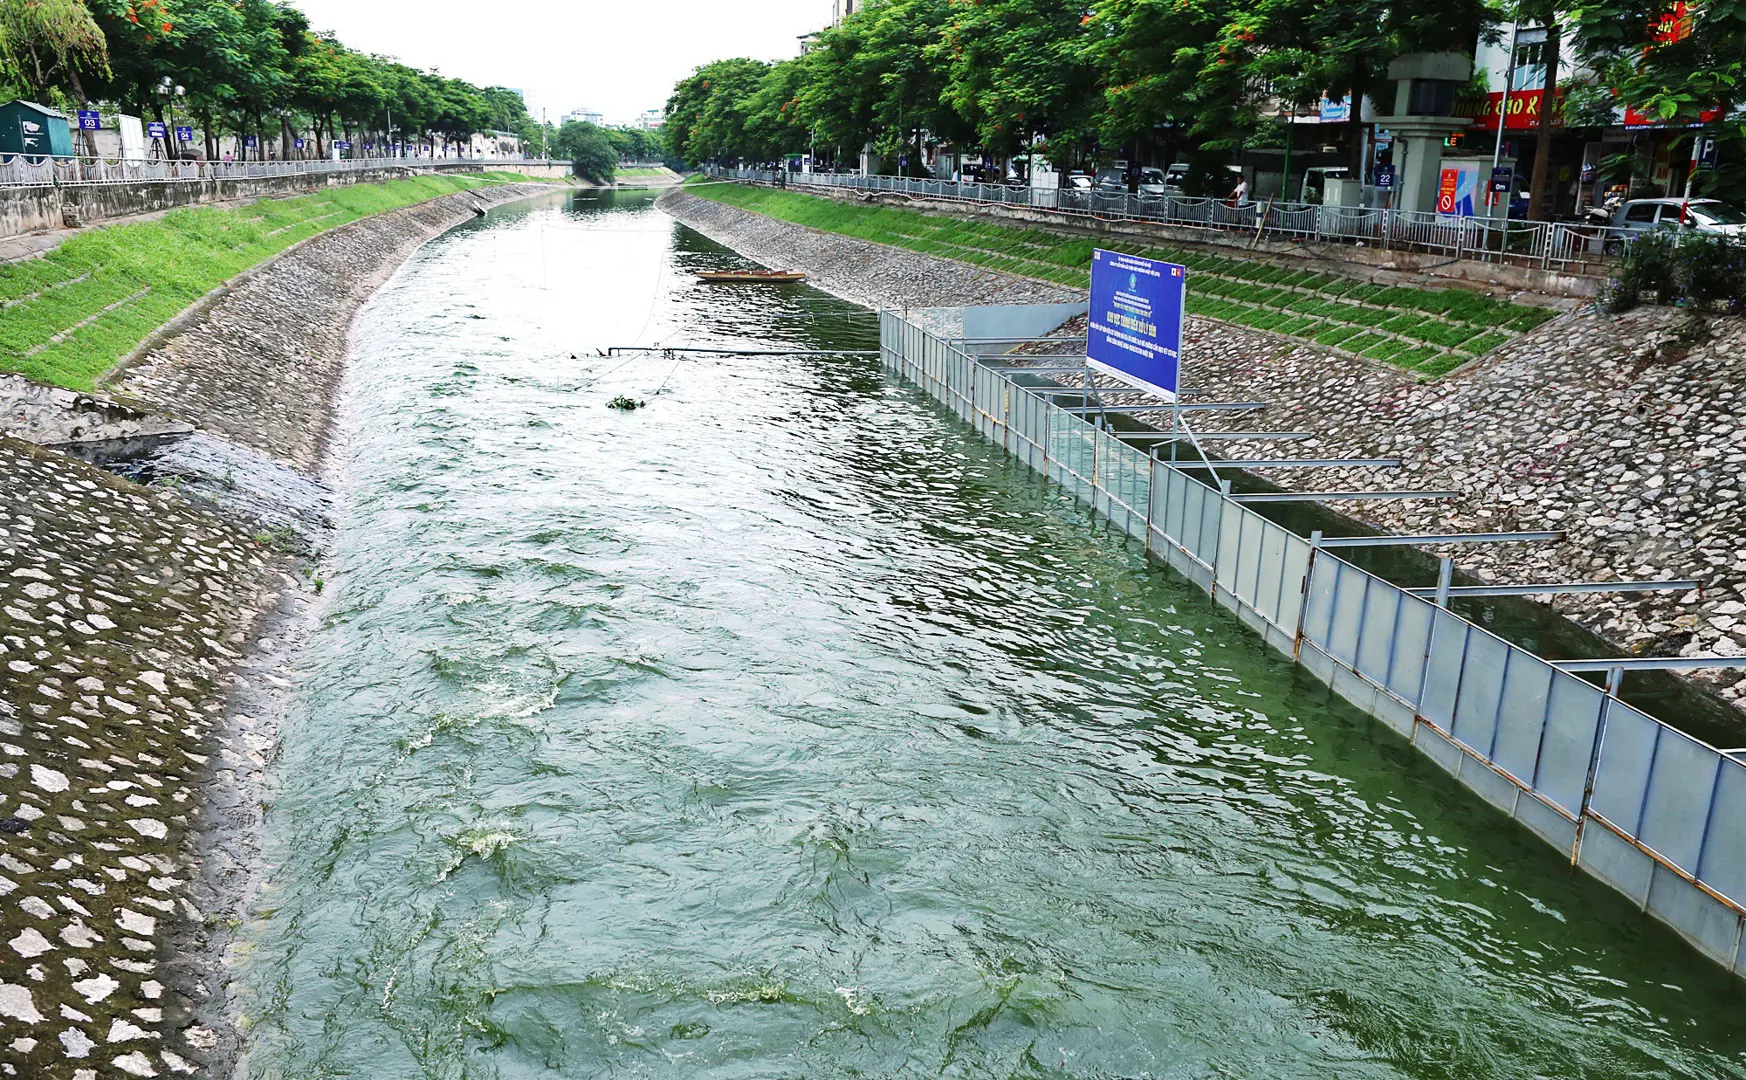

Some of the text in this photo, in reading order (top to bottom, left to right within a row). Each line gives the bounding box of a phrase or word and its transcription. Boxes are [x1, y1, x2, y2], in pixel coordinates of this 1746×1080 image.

[85, 119, 96, 127] 03
[1702, 139, 1715, 159] P
[1380, 174, 1391, 183] 22
